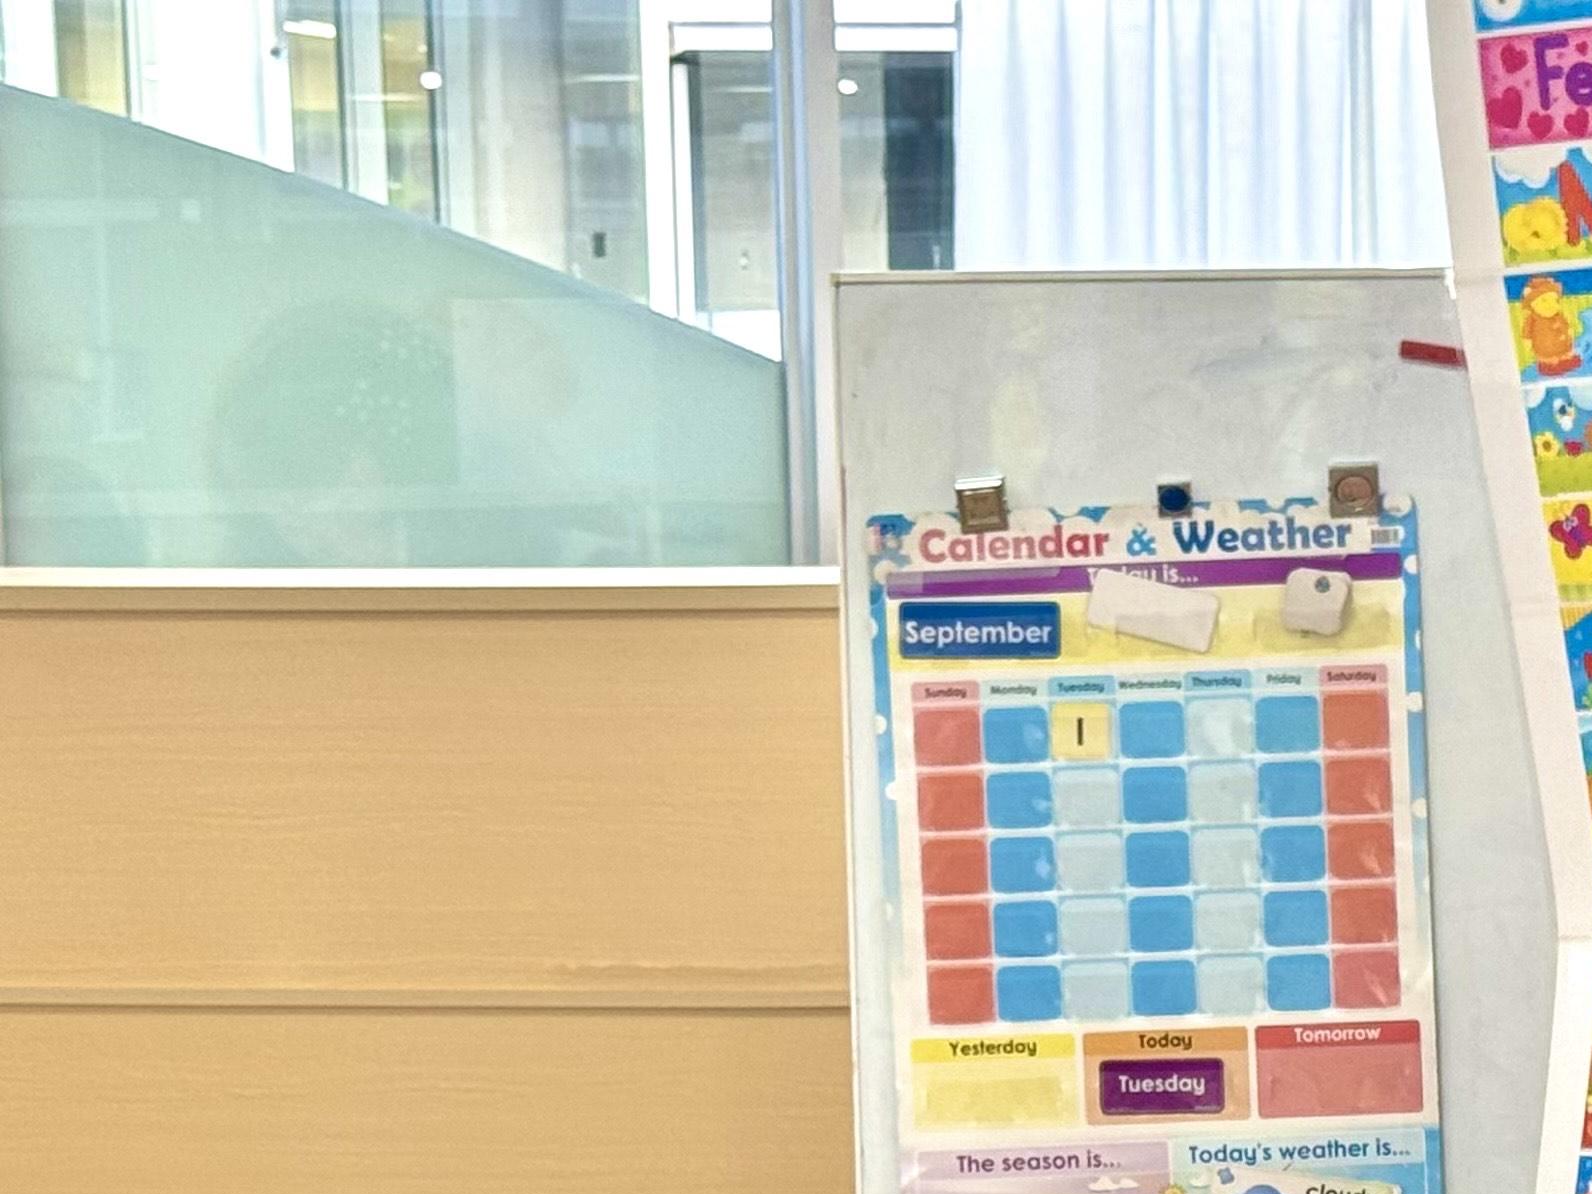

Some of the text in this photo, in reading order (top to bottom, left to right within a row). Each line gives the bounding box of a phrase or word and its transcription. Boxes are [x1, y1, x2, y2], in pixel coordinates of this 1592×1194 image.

[918, 517, 1353, 564] Calendar & Weather
[904, 620, 1053, 649] September
[924, 671, 1377, 699] Sunday Monday Tuesday Wednesday Thursday Friday Saturday
[1138, 1032, 1194, 1051] Today
[1293, 1024, 1382, 1043] Tomorrow
[948, 1039, 1038, 1058] Yesterday
[1118, 1072, 1206, 1097] Tuesday
[956, 1154, 995, 1173] The
[1002, 1154, 1082, 1171] season
[1188, 1142, 1273, 1166] Today's
[1280, 1139, 1368, 1161] weather
